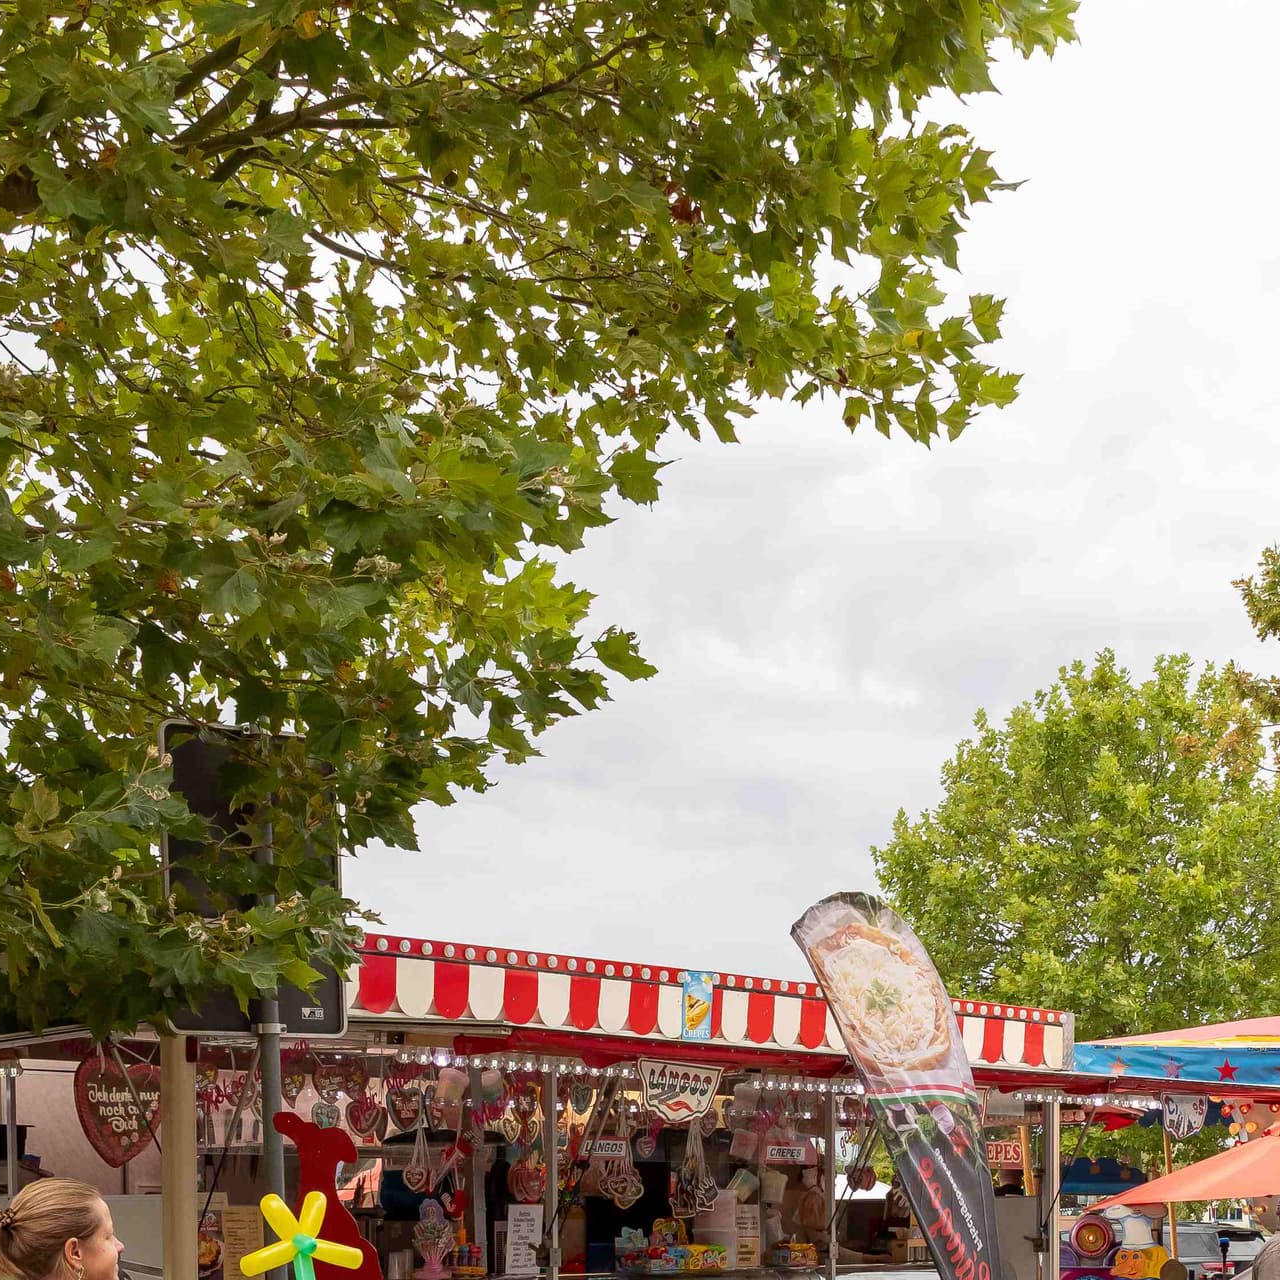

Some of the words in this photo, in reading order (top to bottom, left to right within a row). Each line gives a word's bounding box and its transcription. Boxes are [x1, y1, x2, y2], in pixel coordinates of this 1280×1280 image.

[648, 1065, 713, 1096] LÁNGOS
[99, 1103, 126, 1117] noch
[108, 1116, 139, 1132] Dich
[770, 1147, 801, 1158] CREPES
[986, 1143, 1022, 1161] EPES
